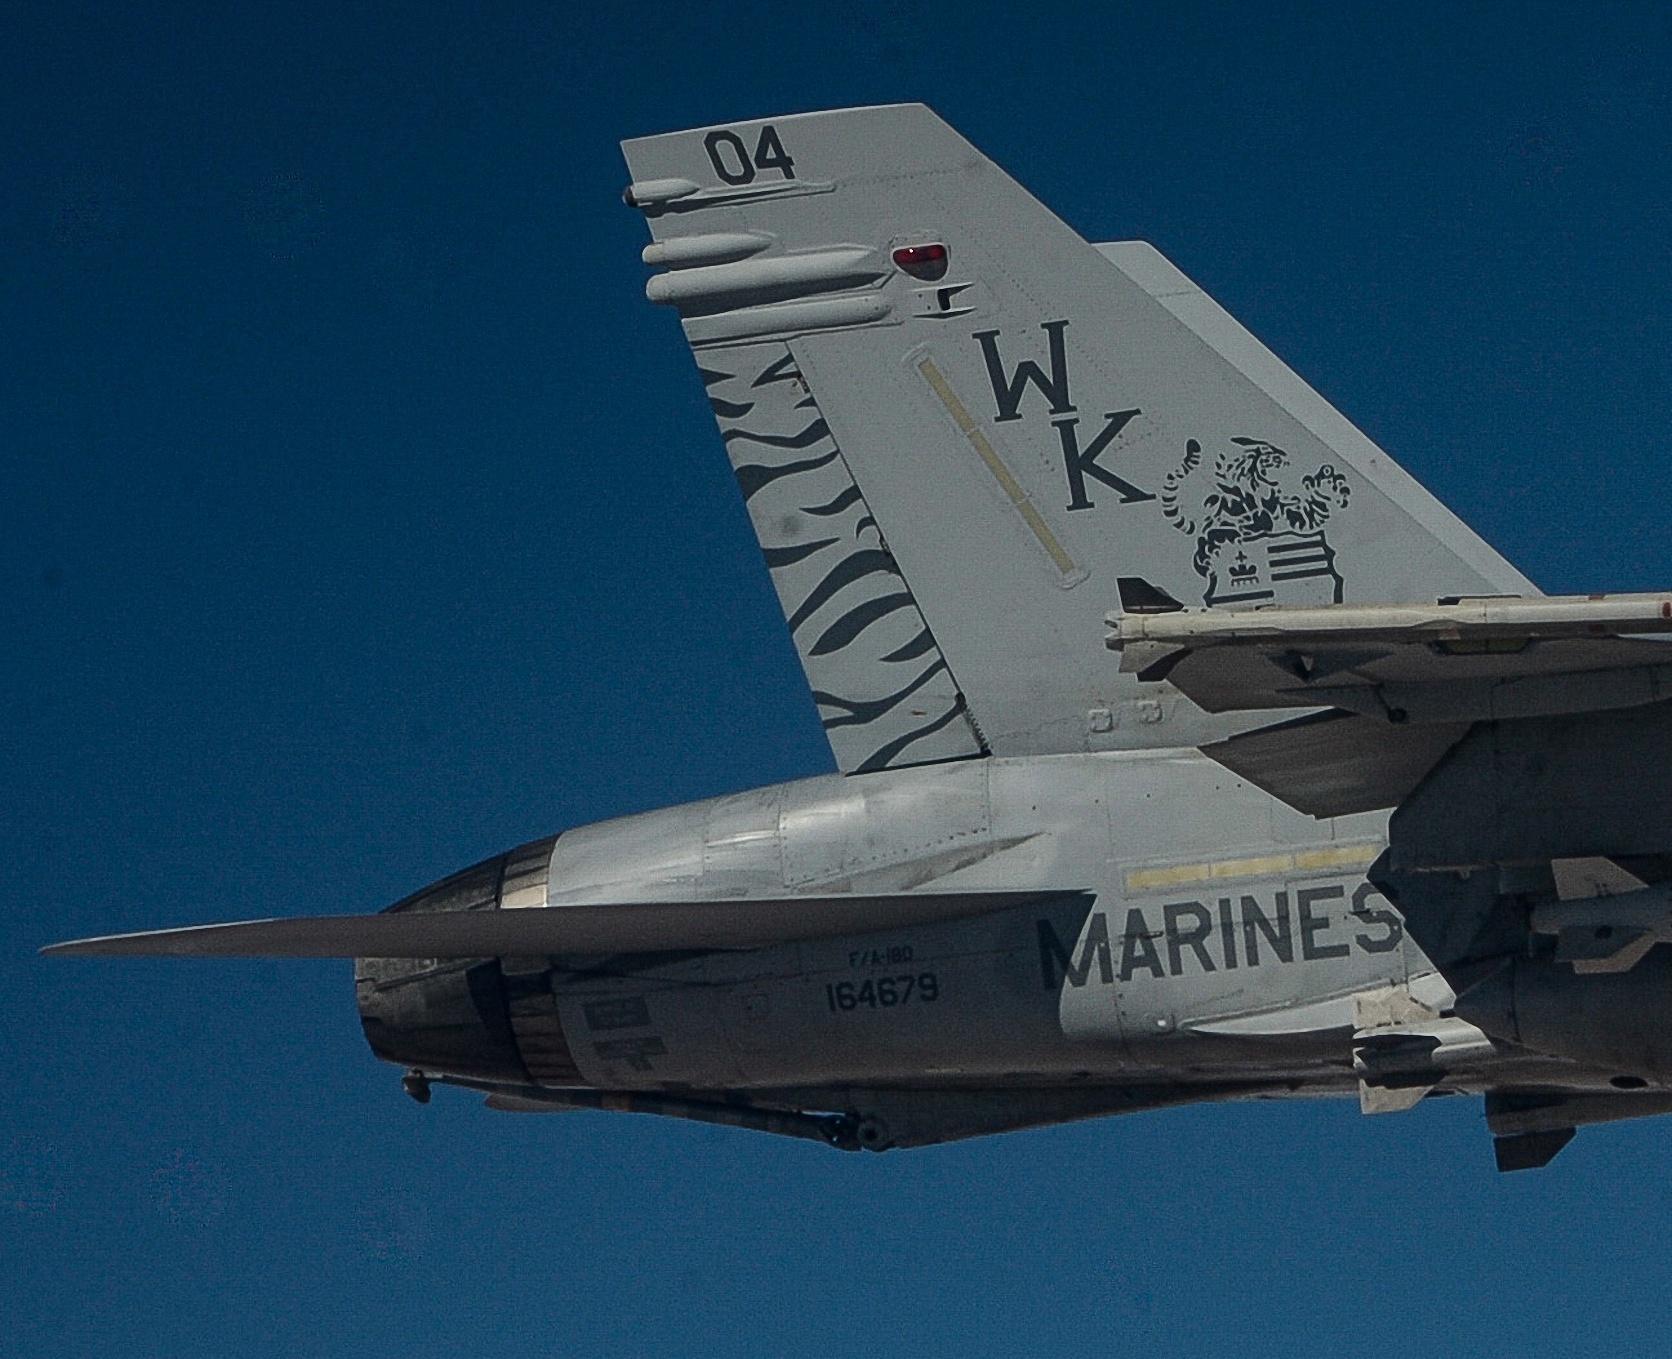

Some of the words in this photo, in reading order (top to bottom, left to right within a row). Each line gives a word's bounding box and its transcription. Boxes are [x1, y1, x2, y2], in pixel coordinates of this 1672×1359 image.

[704, 125, 794, 186] 04
[1036, 881, 1404, 990] MARINES
[826, 972, 940, 1012] 164679
